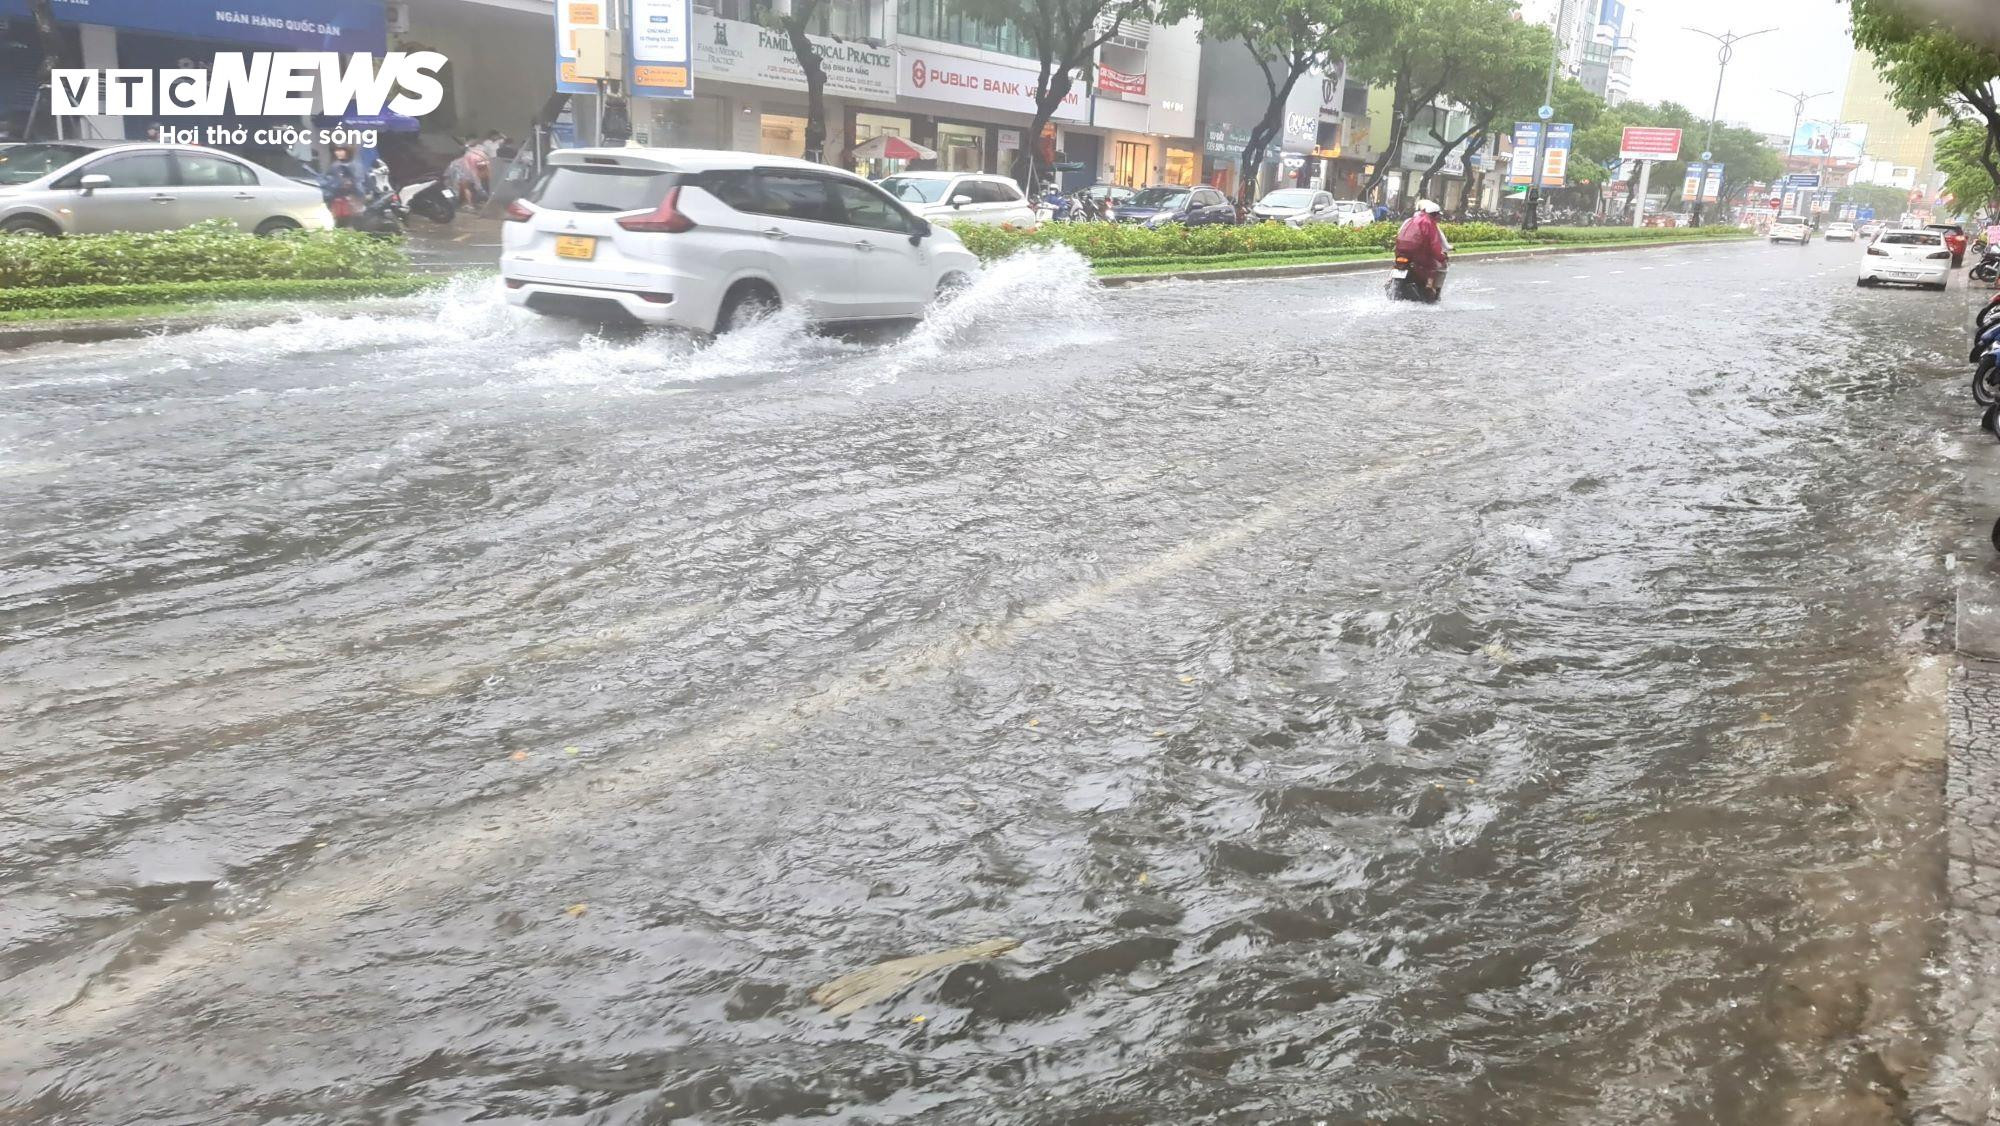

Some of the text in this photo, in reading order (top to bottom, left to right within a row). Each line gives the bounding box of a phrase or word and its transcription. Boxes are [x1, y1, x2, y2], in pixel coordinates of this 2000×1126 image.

[215, 11, 249, 25] NGÂN
[251, 14, 284, 29] HÀNG
[286, 18, 316, 33] QUỐC
[758, 31, 797, 52] FAMIL
[847, 47, 891, 68] PRACTICE
[930, 69, 979, 89] PUBLIC
[983, 79, 1020, 96] BANK
